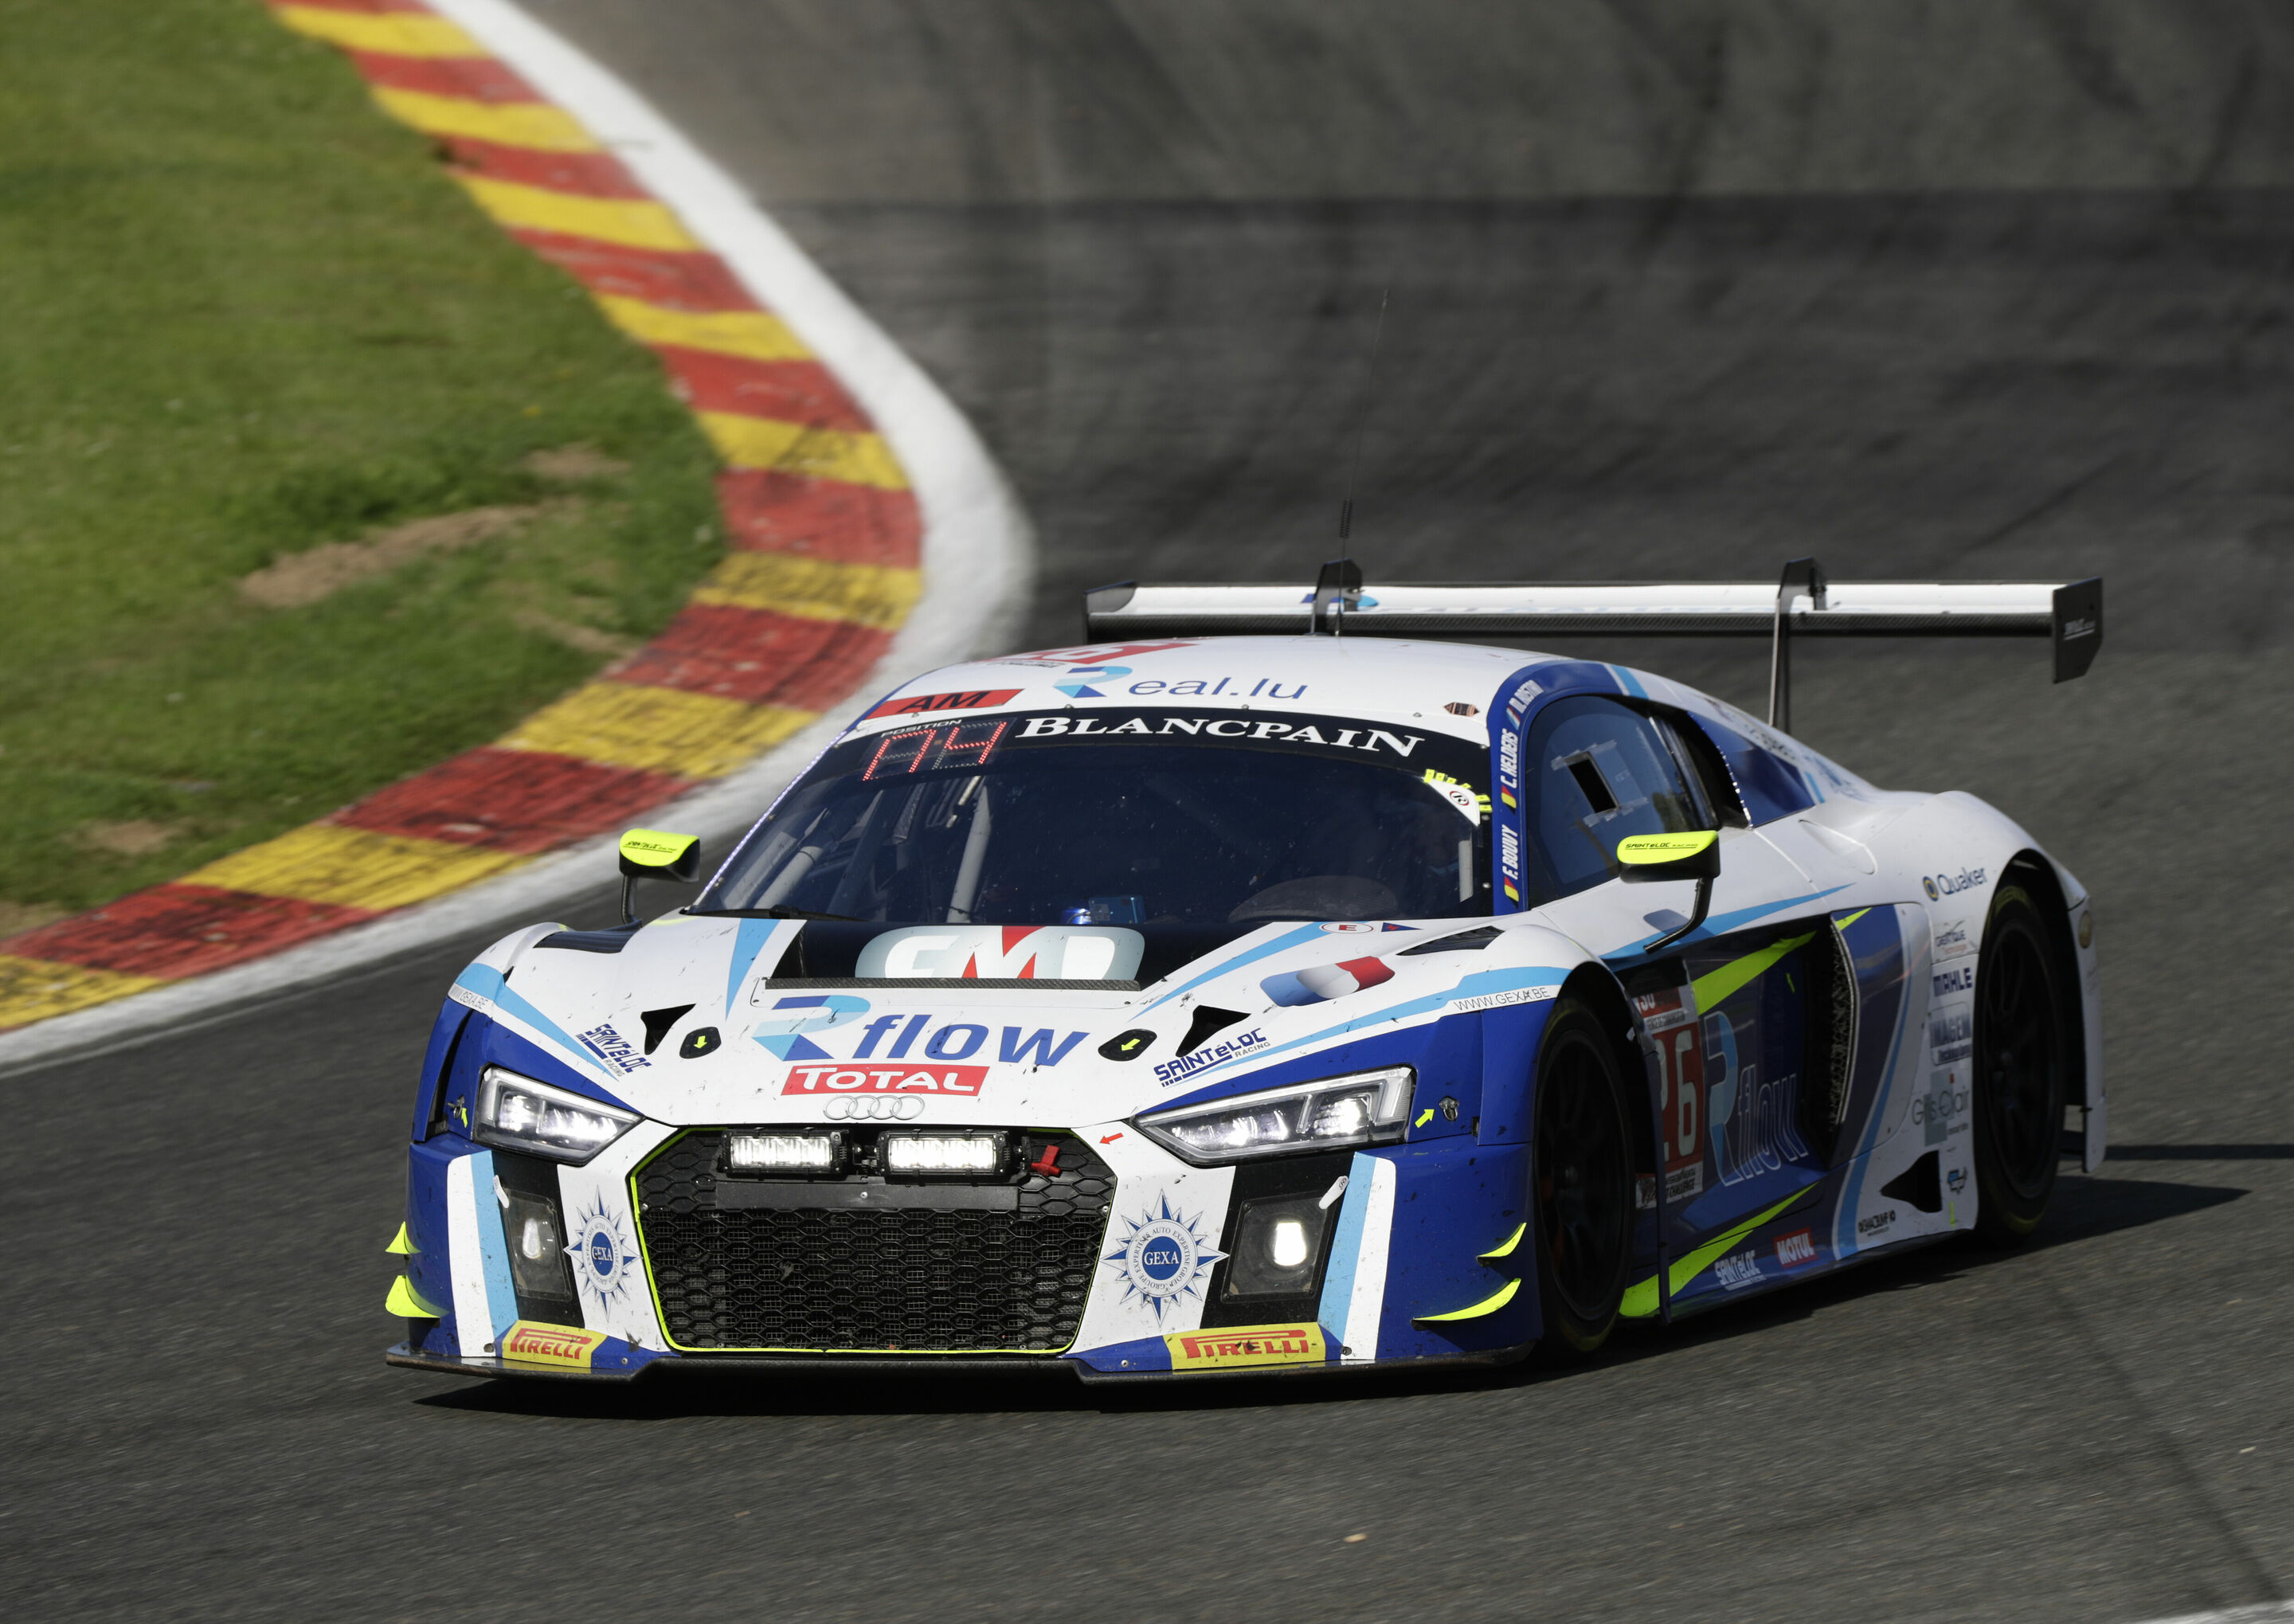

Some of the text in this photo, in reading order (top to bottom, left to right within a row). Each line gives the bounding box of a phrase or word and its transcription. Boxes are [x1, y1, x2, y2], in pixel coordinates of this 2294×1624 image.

[898, 691, 991, 713] AM
[881, 718, 961, 738] POSITION
[1016, 716, 1425, 757] BLANCPAIN
[1937, 867, 1987, 895] Quaker
[1932, 967, 1972, 997] MAHLE
[1454, 987, 1551, 1012] WWW.GEXA.BE
[1235, 1041, 1271, 1058] RACING
[795, 1066, 974, 1094] TOTAL
[591, 1246, 613, 1262] GEXA
[1143, 1250, 1180, 1266] GEXA
[1777, 1232, 1815, 1265] MOTUL
[509, 1328, 593, 1359] PIRELLI
[1180, 1329, 1309, 1359] PIRELLI
